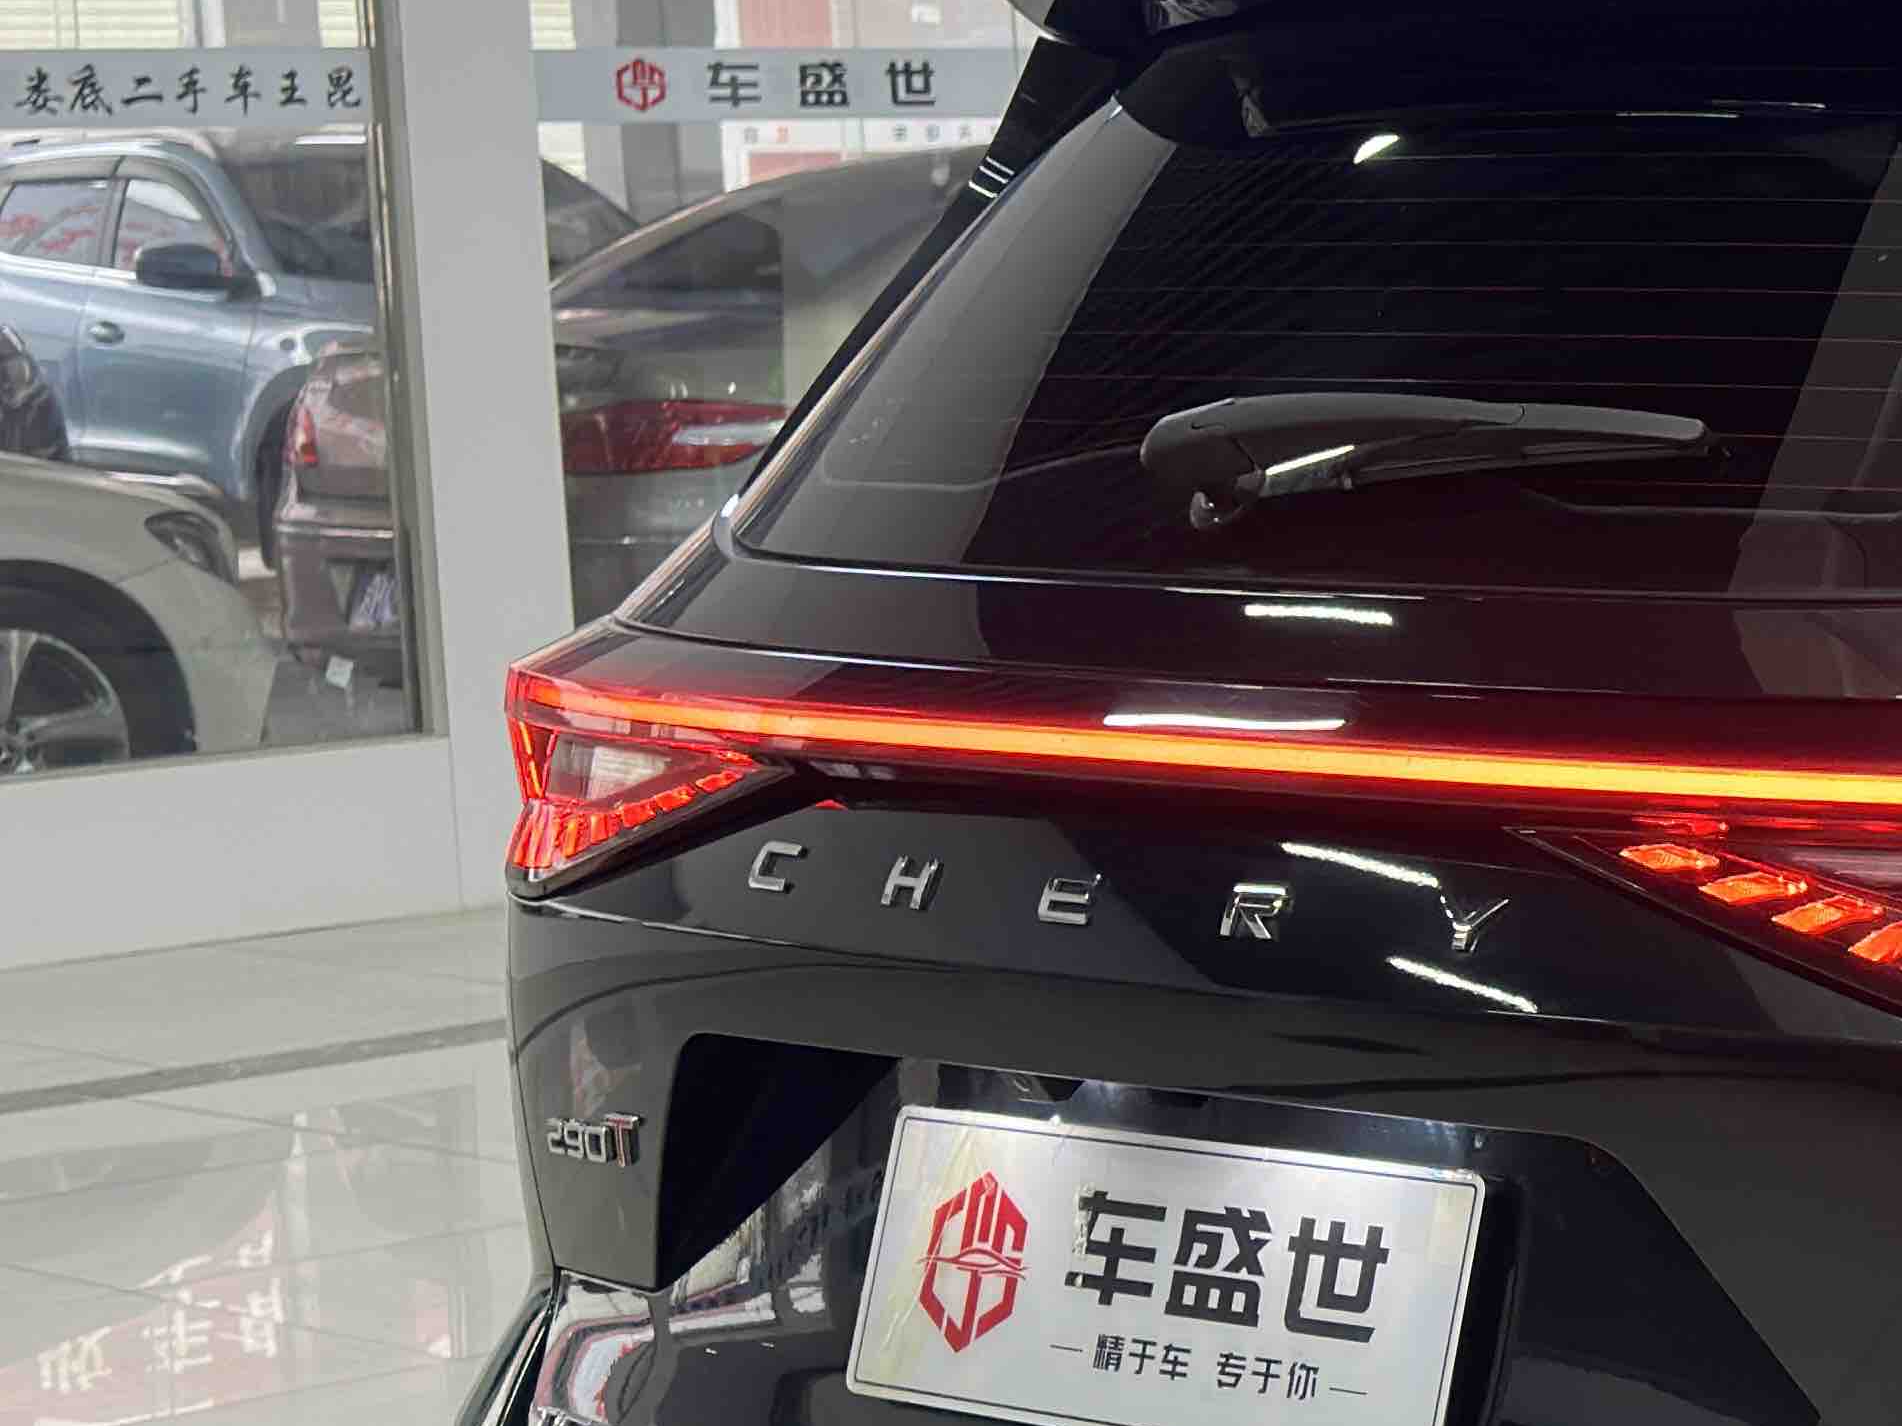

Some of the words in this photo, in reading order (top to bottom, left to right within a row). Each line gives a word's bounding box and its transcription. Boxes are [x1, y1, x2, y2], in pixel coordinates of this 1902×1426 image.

[707, 60, 936, 107] 车盛世
[747, 840, 1508, 953] CHERY
[546, 1114, 643, 1167] 290T
[1063, 1186, 1390, 1344] 车盛世
[1092, 1333, 1191, 1384] 精于车
[1216, 1351, 1320, 1402] 专于你
